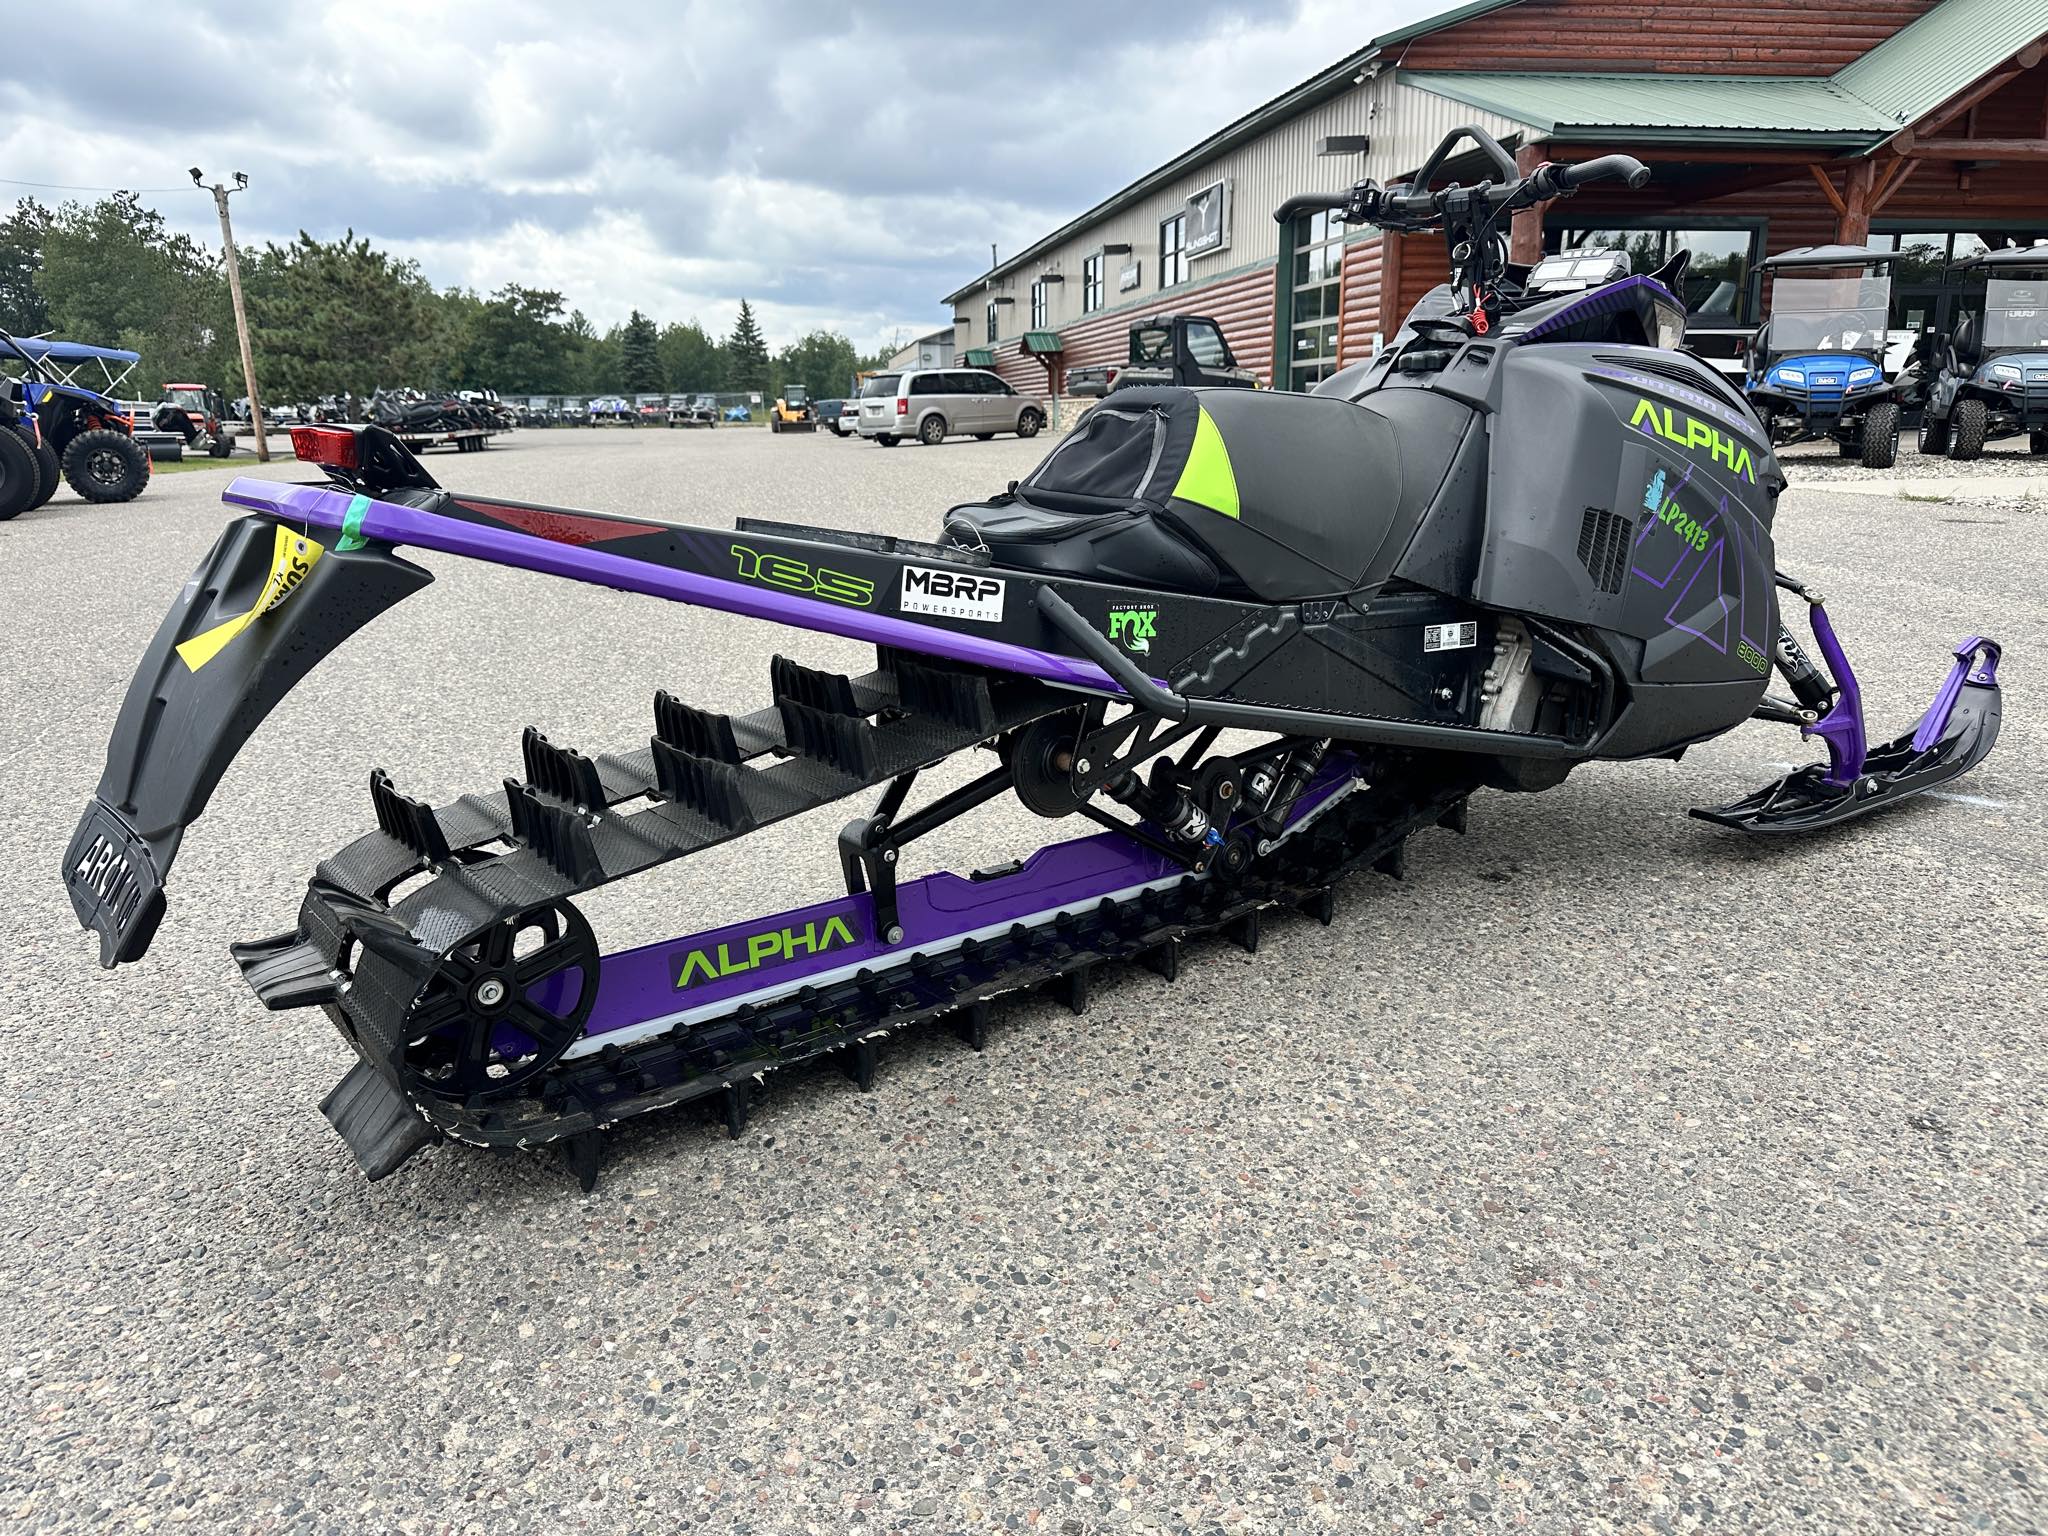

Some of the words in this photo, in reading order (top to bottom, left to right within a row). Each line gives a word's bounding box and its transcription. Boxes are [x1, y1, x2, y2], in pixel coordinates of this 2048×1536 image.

[1630, 398, 1756, 485] ALPHA
[1658, 496, 1709, 552] LP2413
[731, 544, 875, 606] 165
[904, 568, 1001, 601] MBRP
[903, 601, 1000, 621] POWERSPORTS
[1109, 610, 1157, 650] FOX
[1736, 640, 1768, 675] 8000
[677, 916, 855, 988] ALPHA
